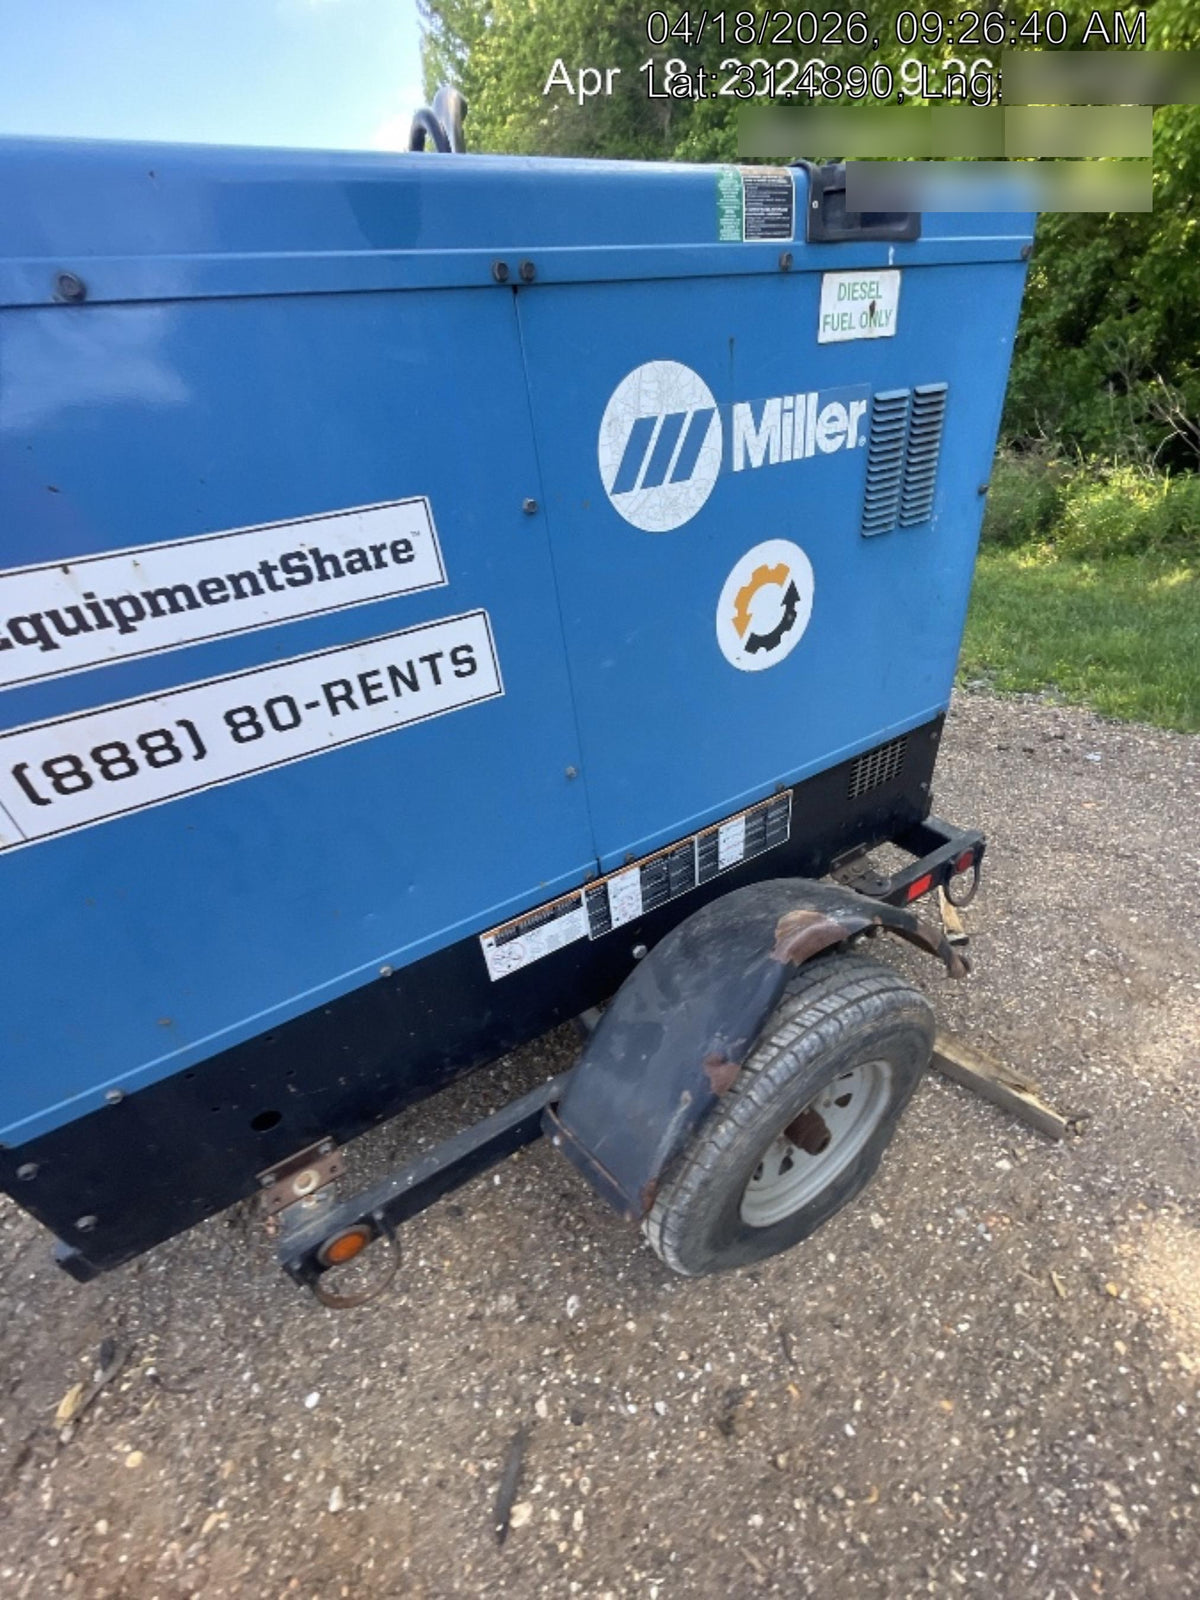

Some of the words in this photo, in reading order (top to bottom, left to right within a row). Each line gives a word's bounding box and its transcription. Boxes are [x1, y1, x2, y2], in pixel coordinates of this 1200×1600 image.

[822, 311, 856, 333] FUEL
[859, 308, 893, 330] ONLY
[837, 280, 883, 302] DIESEL
[732, 391, 867, 472] Miller
[0, 538, 415, 653] quipmentShare
[11, 718, 208, 807] (888)
[222, 643, 478, 745] 80-RENTS
